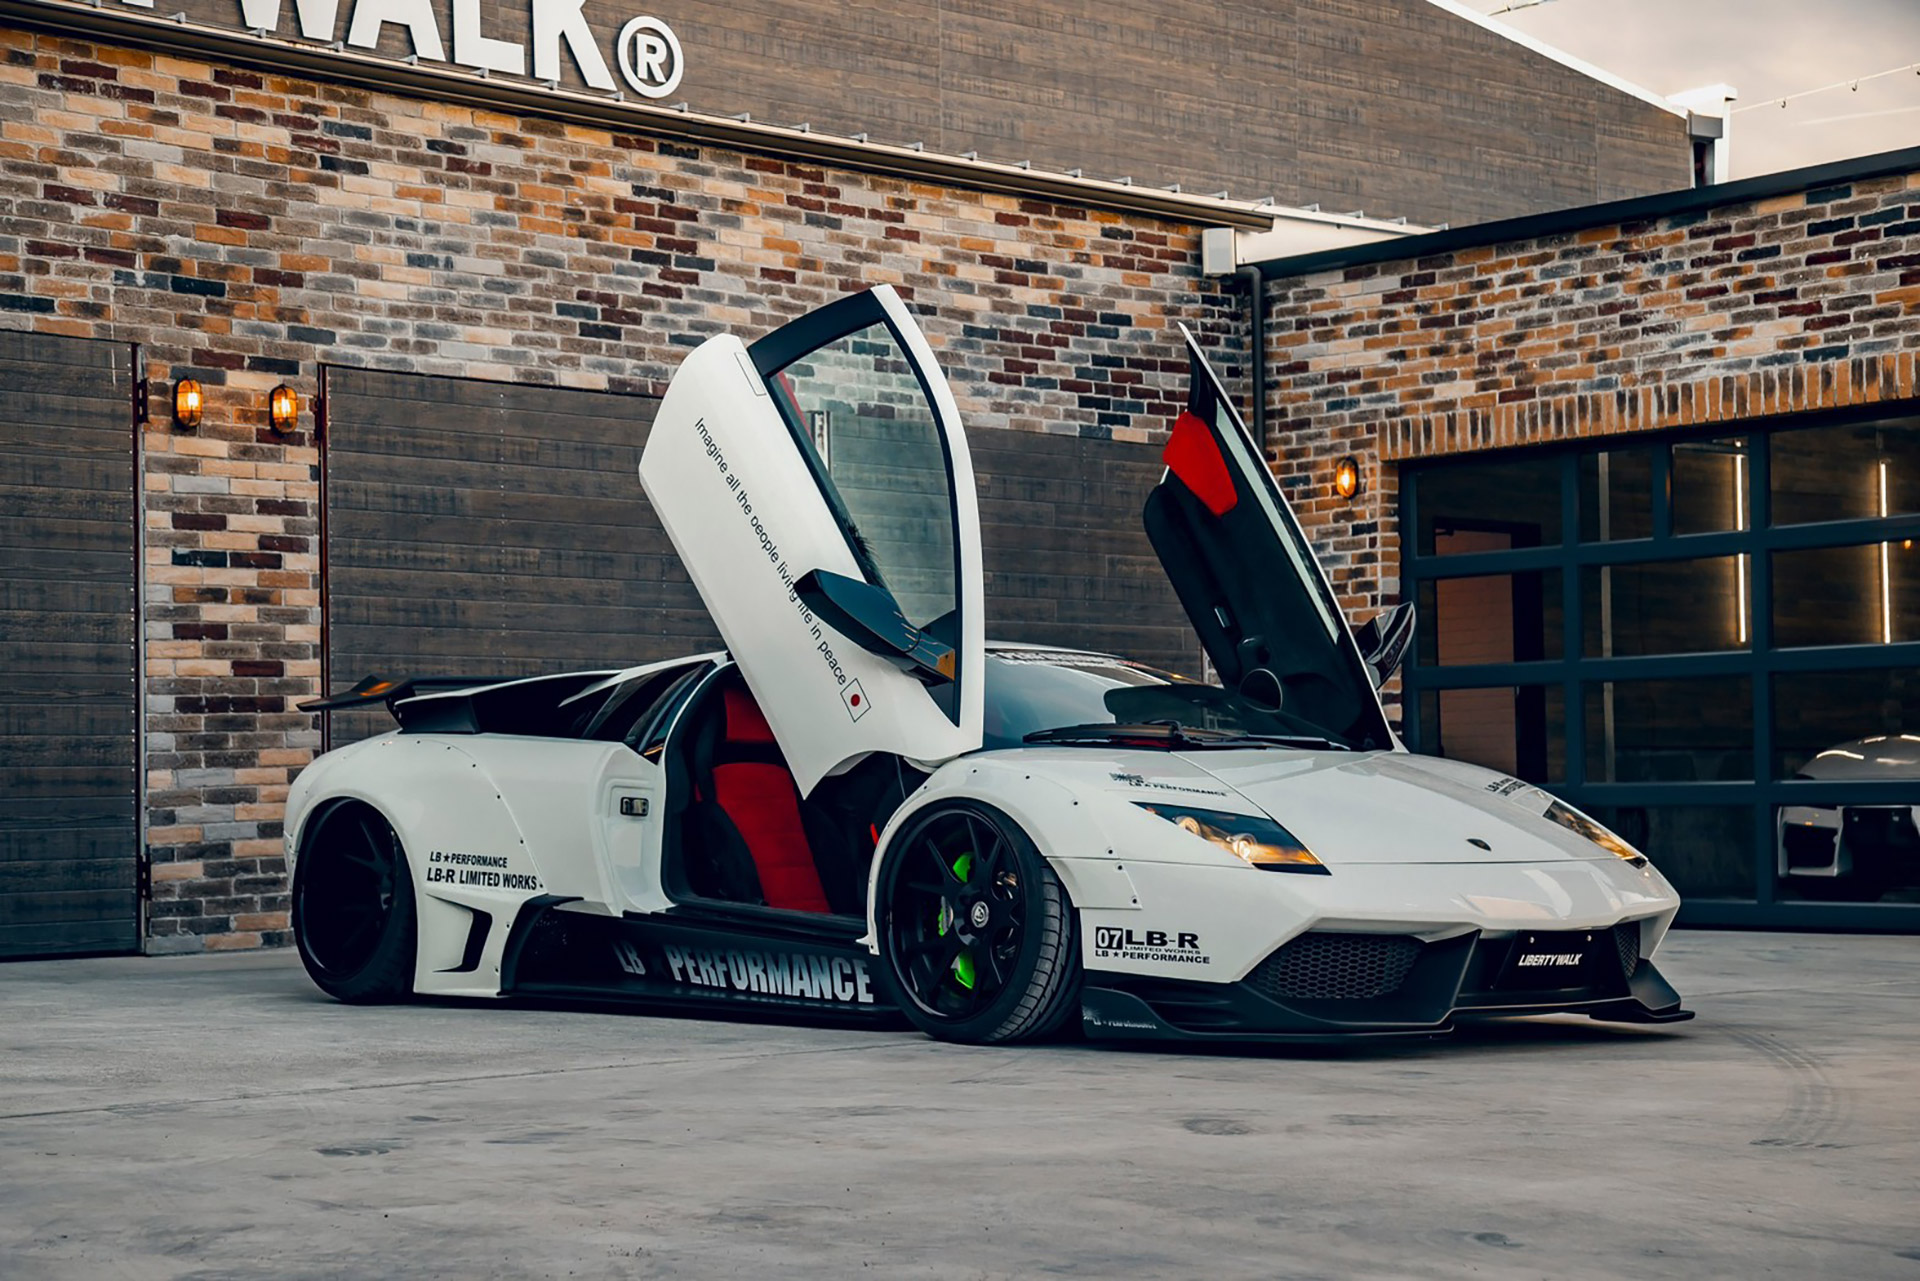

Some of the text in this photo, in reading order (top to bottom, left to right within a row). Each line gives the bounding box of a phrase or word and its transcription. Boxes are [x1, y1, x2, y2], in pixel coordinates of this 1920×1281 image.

[695, 418, 728, 473] Imagine
[726, 474, 741, 492] all
[737, 490, 752, 515] the
[750, 516, 779, 563] people
[777, 561, 798, 602] living
[810, 622, 822, 640] in
[817, 641, 846, 685] peace
[429, 851, 508, 868] LB PERFORMANCE
[427, 867, 537, 890] LB-R LIMITED WORKS
[1097, 928, 1122, 949] 07
[1125, 929, 1200, 949] LB-R
[1095, 950, 1210, 964] LB PERFORMANCE
[612, 941, 874, 1003] LB PERFORMANCE
